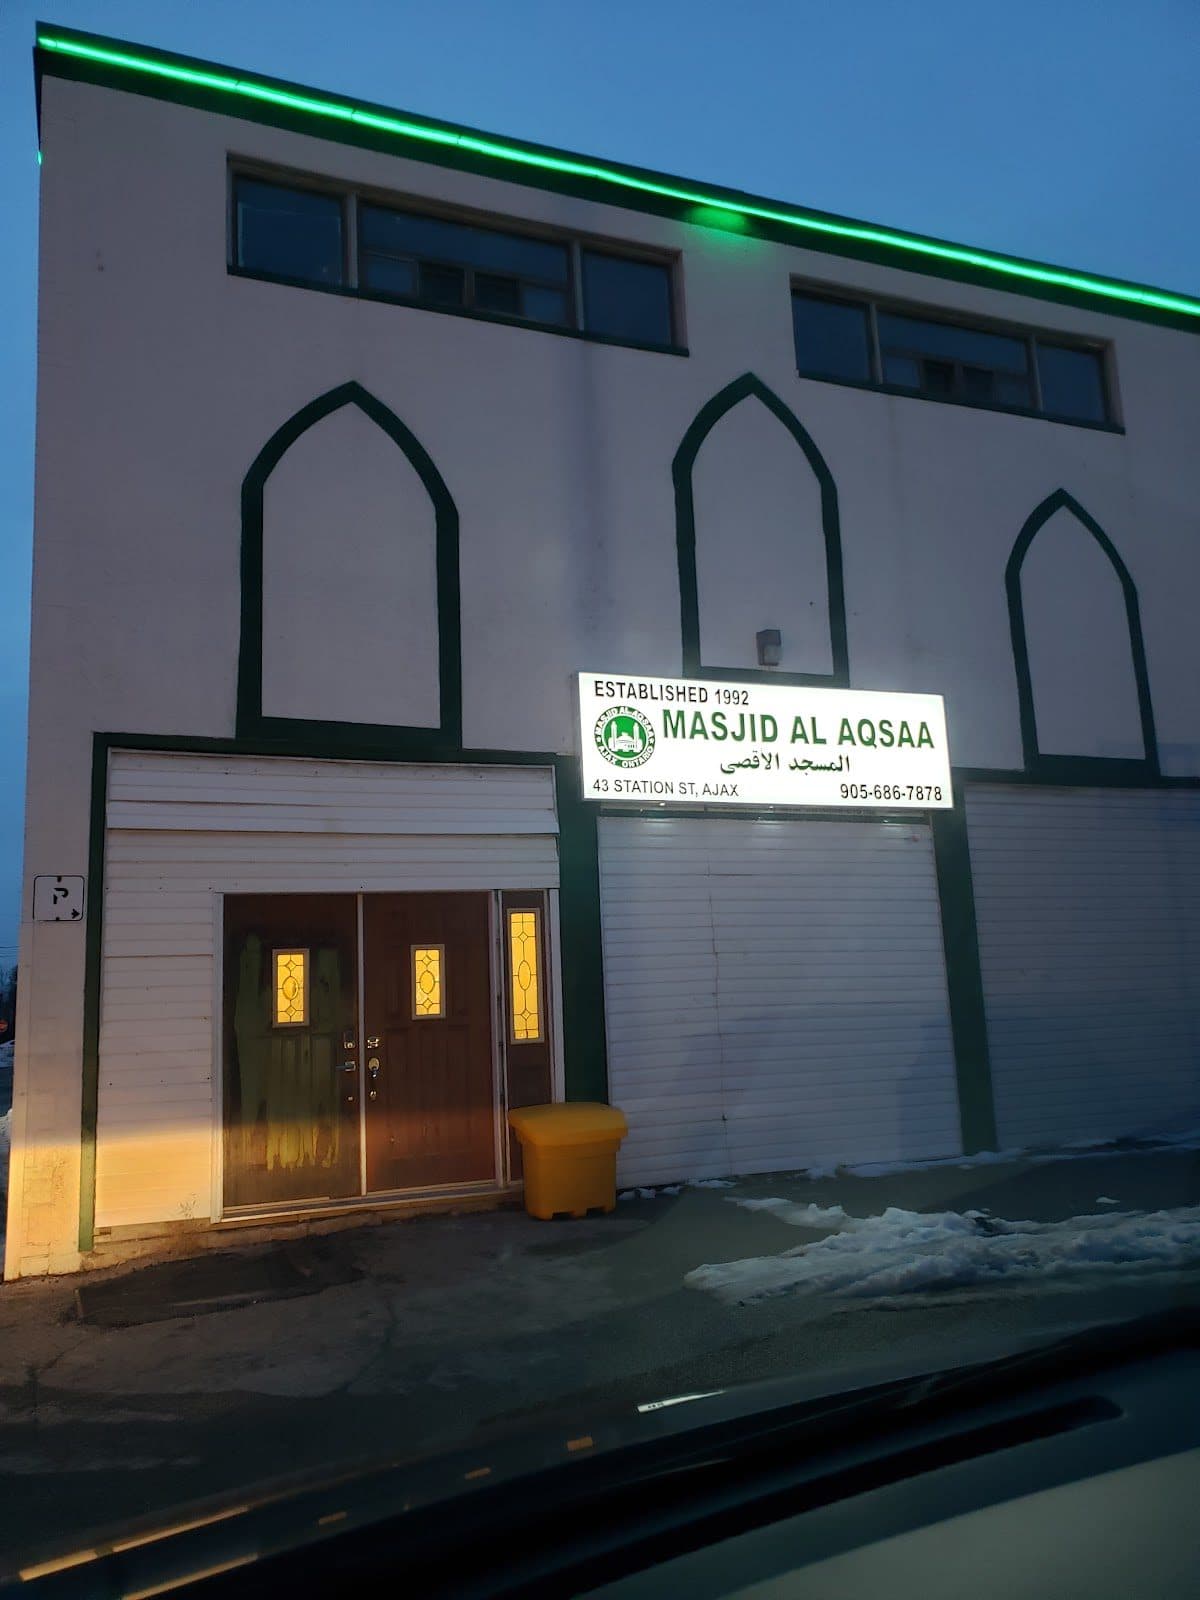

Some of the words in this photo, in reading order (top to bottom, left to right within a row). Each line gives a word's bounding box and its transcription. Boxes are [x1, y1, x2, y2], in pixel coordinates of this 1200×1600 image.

[594, 680, 708, 703] ESTABLISHED
[714, 688, 750, 706] 1992
[662, 709, 779, 744] MASJID
[790, 716, 827, 745] AL
[838, 718, 935, 748] AQSAA
[788, 754, 850, 776] المسجد
[593, 779, 609, 792] 43
[613, 779, 674, 795] STATION
[678, 781, 699, 797] ST,
[703, 783, 740, 797] AJAX
[840, 783, 943, 801] 905-686-7878
